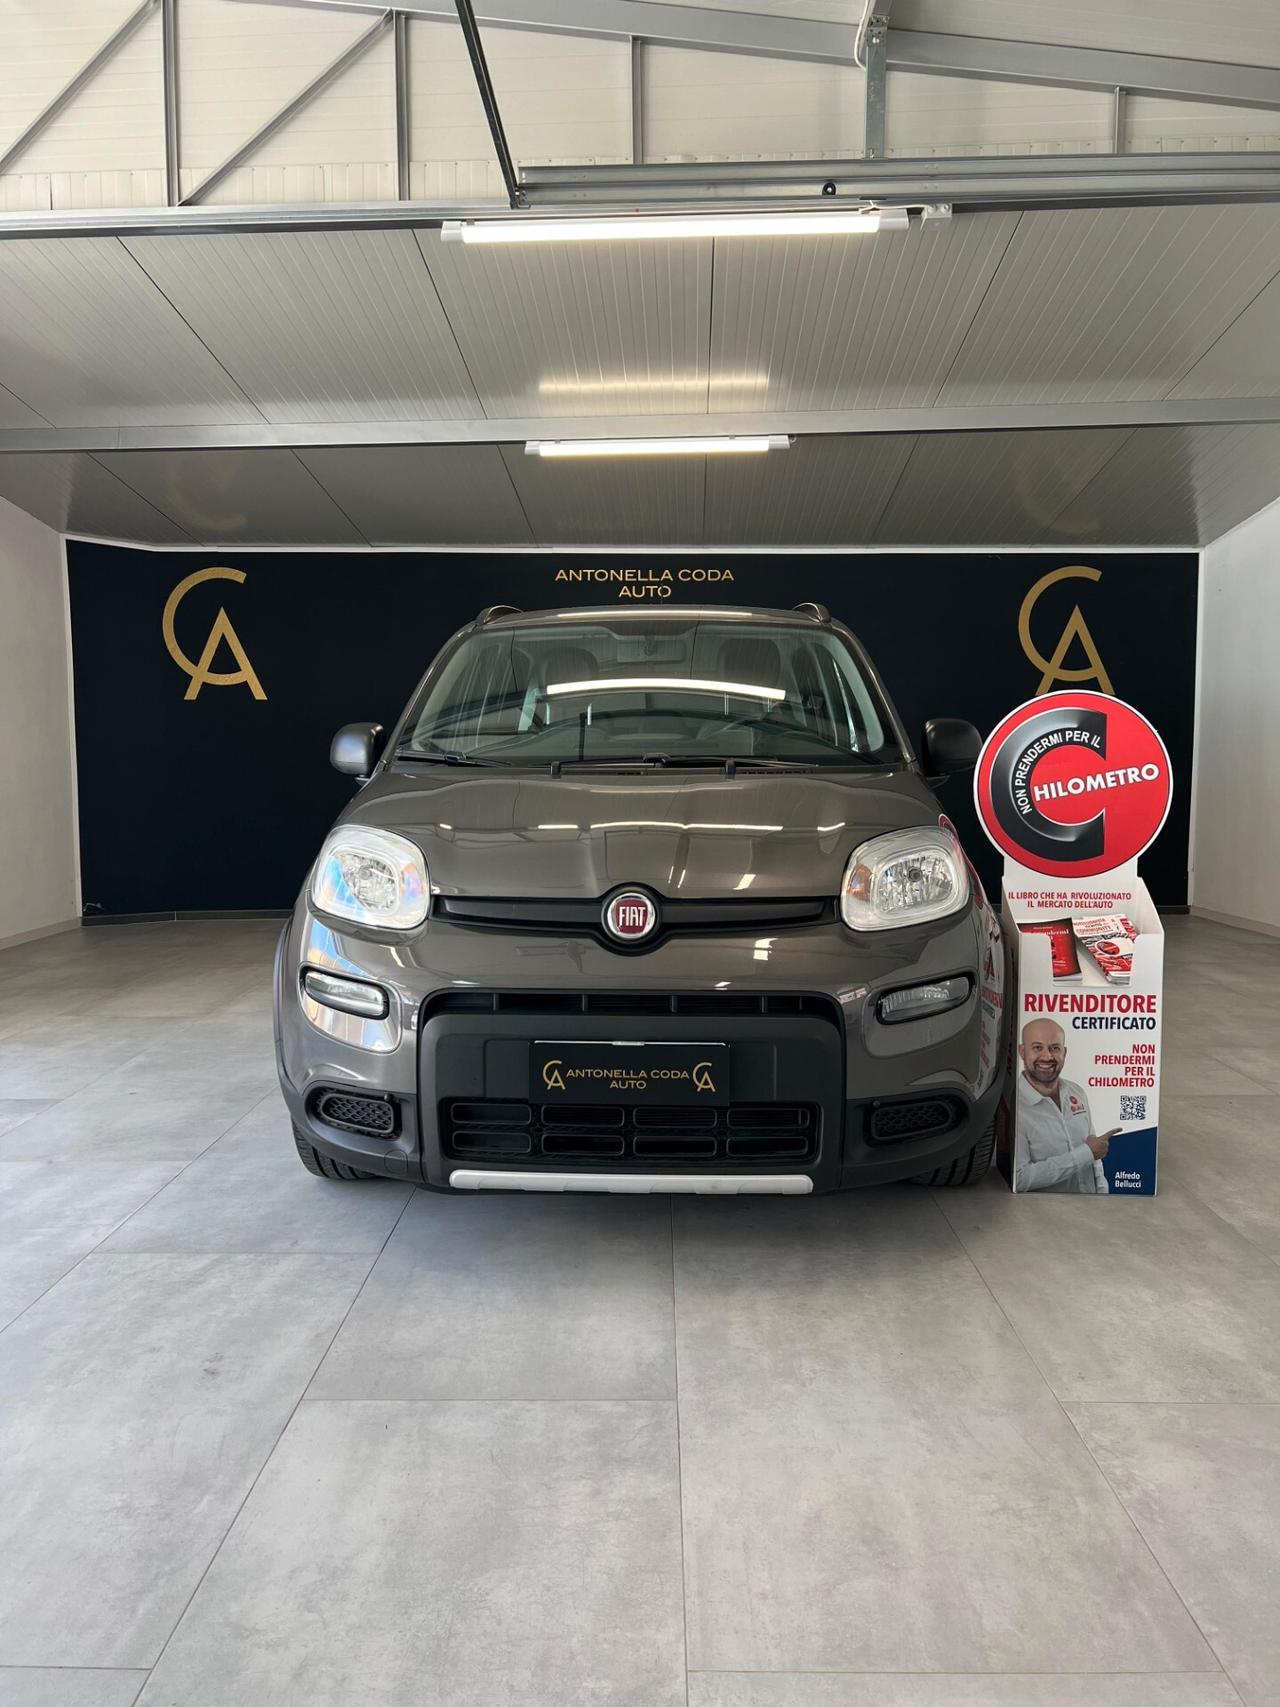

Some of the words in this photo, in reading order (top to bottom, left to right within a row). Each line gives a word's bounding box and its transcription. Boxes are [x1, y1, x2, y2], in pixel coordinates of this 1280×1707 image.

[555, 569, 674, 582] ANTONELLA
[678, 569, 735, 582] CODA
[618, 585, 672, 598] AUTO
[1065, 730, 1089, 742] PER
[1090, 735, 1101, 749] IL
[1014, 731, 1063, 786] PRENDERMI
[1015, 788, 1033, 815] NON
[1008, 892, 1016, 900] IL
[1016, 892, 1039, 900] LIBRO
[1040, 892, 1056, 900] CHE
[1056, 892, 1068, 900] HA
[1071, 892, 1132, 900] RIVOLUZIONATO
[1074, 901, 1113, 909] DELL'AUTO
[619, 906, 646, 927] FIAT
[1024, 993, 1157, 1013] RIVENDITORE
[1072, 1017, 1156, 1030] CERTIFICATO
[1132, 1044, 1156, 1054] NON
[1094, 1055, 1155, 1065] PRENDERMI
[566, 1068, 648, 1079] ANTONELLA
[650, 1069, 690, 1079] CODA
[1124, 1067, 1145, 1076] PER
[1146, 1067, 1156, 1076] IL
[609, 1080, 647, 1089] AUTO
[1088, 1077, 1155, 1087] CHILOMETRO
[1115, 1171, 1141, 1179] Alfredo
[1115, 1180, 1142, 1188] Bellucci
